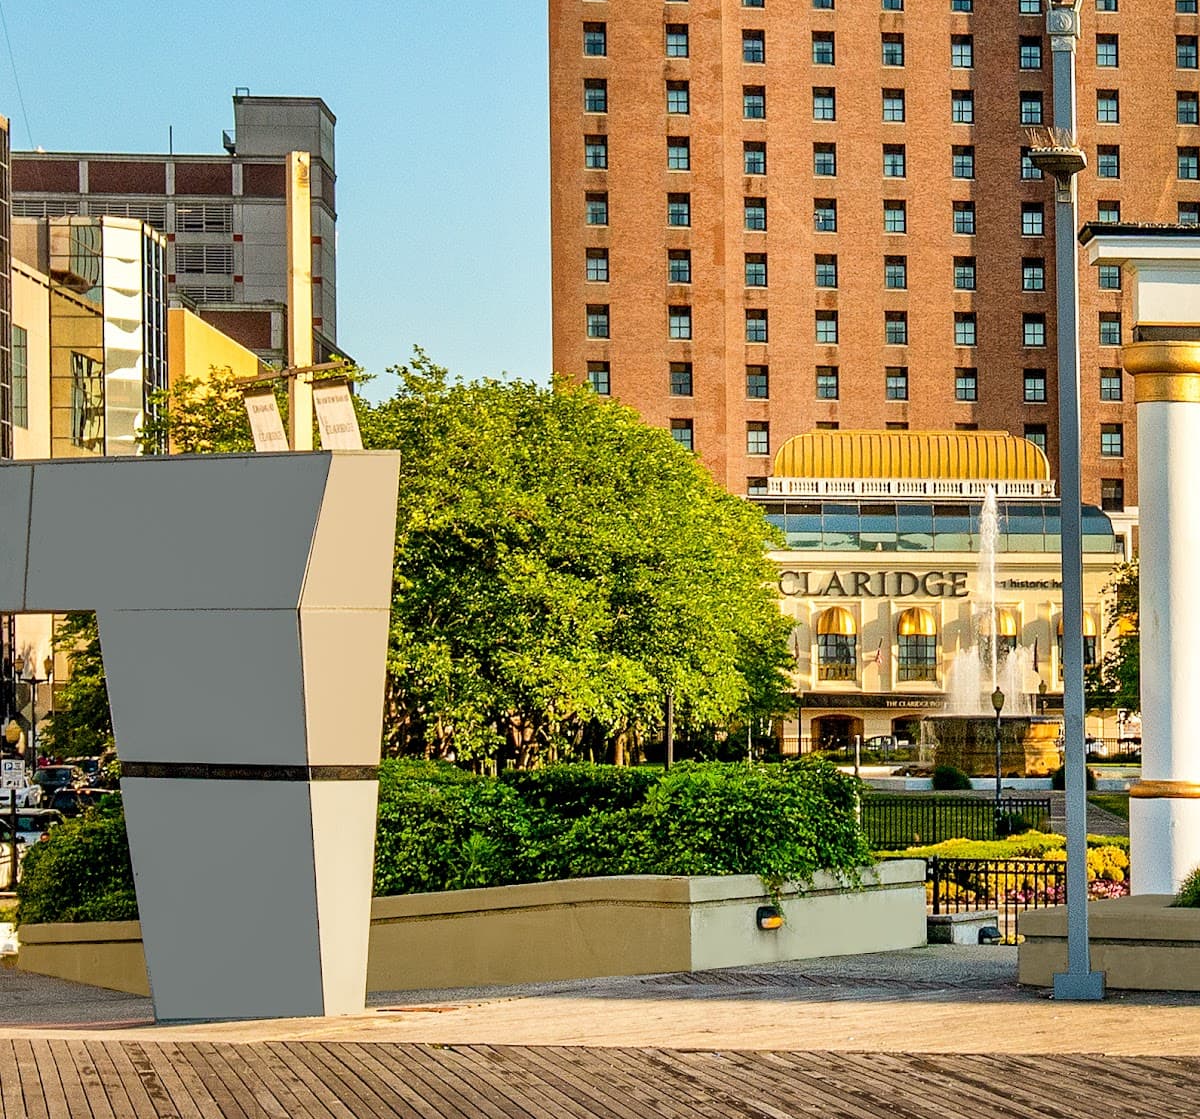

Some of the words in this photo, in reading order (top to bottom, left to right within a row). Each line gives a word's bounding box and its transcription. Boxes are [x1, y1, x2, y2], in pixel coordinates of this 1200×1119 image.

[778, 570, 970, 597] CLARIDGE
[1010, 578, 1049, 588] historic
[886, 700, 897, 708] THE
